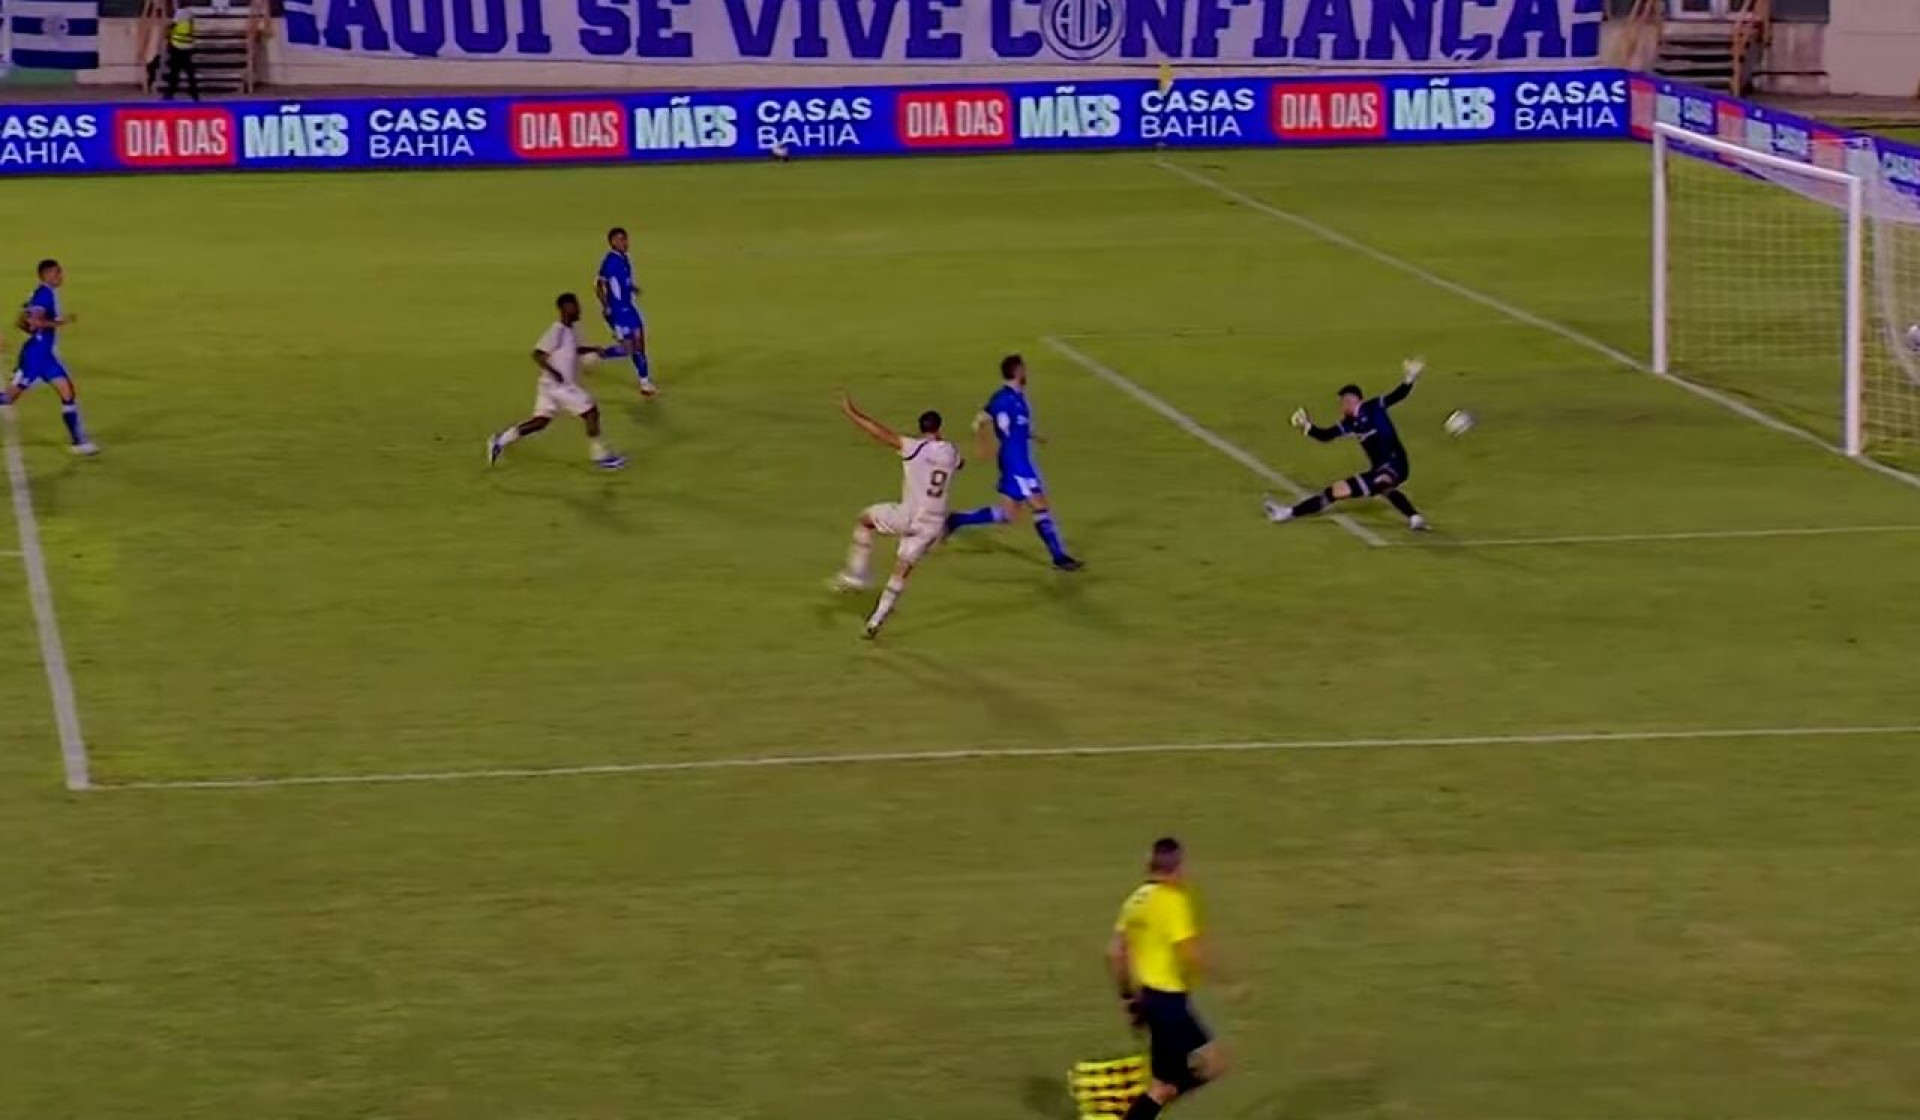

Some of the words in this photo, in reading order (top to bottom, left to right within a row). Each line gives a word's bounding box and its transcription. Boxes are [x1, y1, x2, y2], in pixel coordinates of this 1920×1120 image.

[578, 0, 693, 57] SE
[724, 0, 962, 58] VIVE
[758, 98, 871, 122] CASAS
[908, 103, 948, 137] DIA
[957, 100, 1002, 136] DAS
[1020, 86, 1120, 138] MÃES
[1142, 87, 1254, 112] CASAS
[1282, 94, 1321, 128] DIA
[1332, 93, 1376, 127] DAS
[1394, 78, 1494, 129] MÃES
[0, 115, 97, 138] ASAS
[370, 108, 486, 132] CASAS
[522, 114, 562, 148] DIA
[571, 112, 617, 147] DAS
[635, 96, 736, 149] MÃES
[1142, 116, 1240, 137] BAHIA
[1516, 107, 1617, 129] BAHIA
[127, 120, 169, 156] DIA
[178, 119, 225, 155] DAS
[244, 105, 348, 158] MÃES
[758, 124, 858, 149] BAHIA
[0, 142, 84, 163] AHIA
[370, 135, 473, 157] BAHIA
[927, 470, 948, 498] 9
